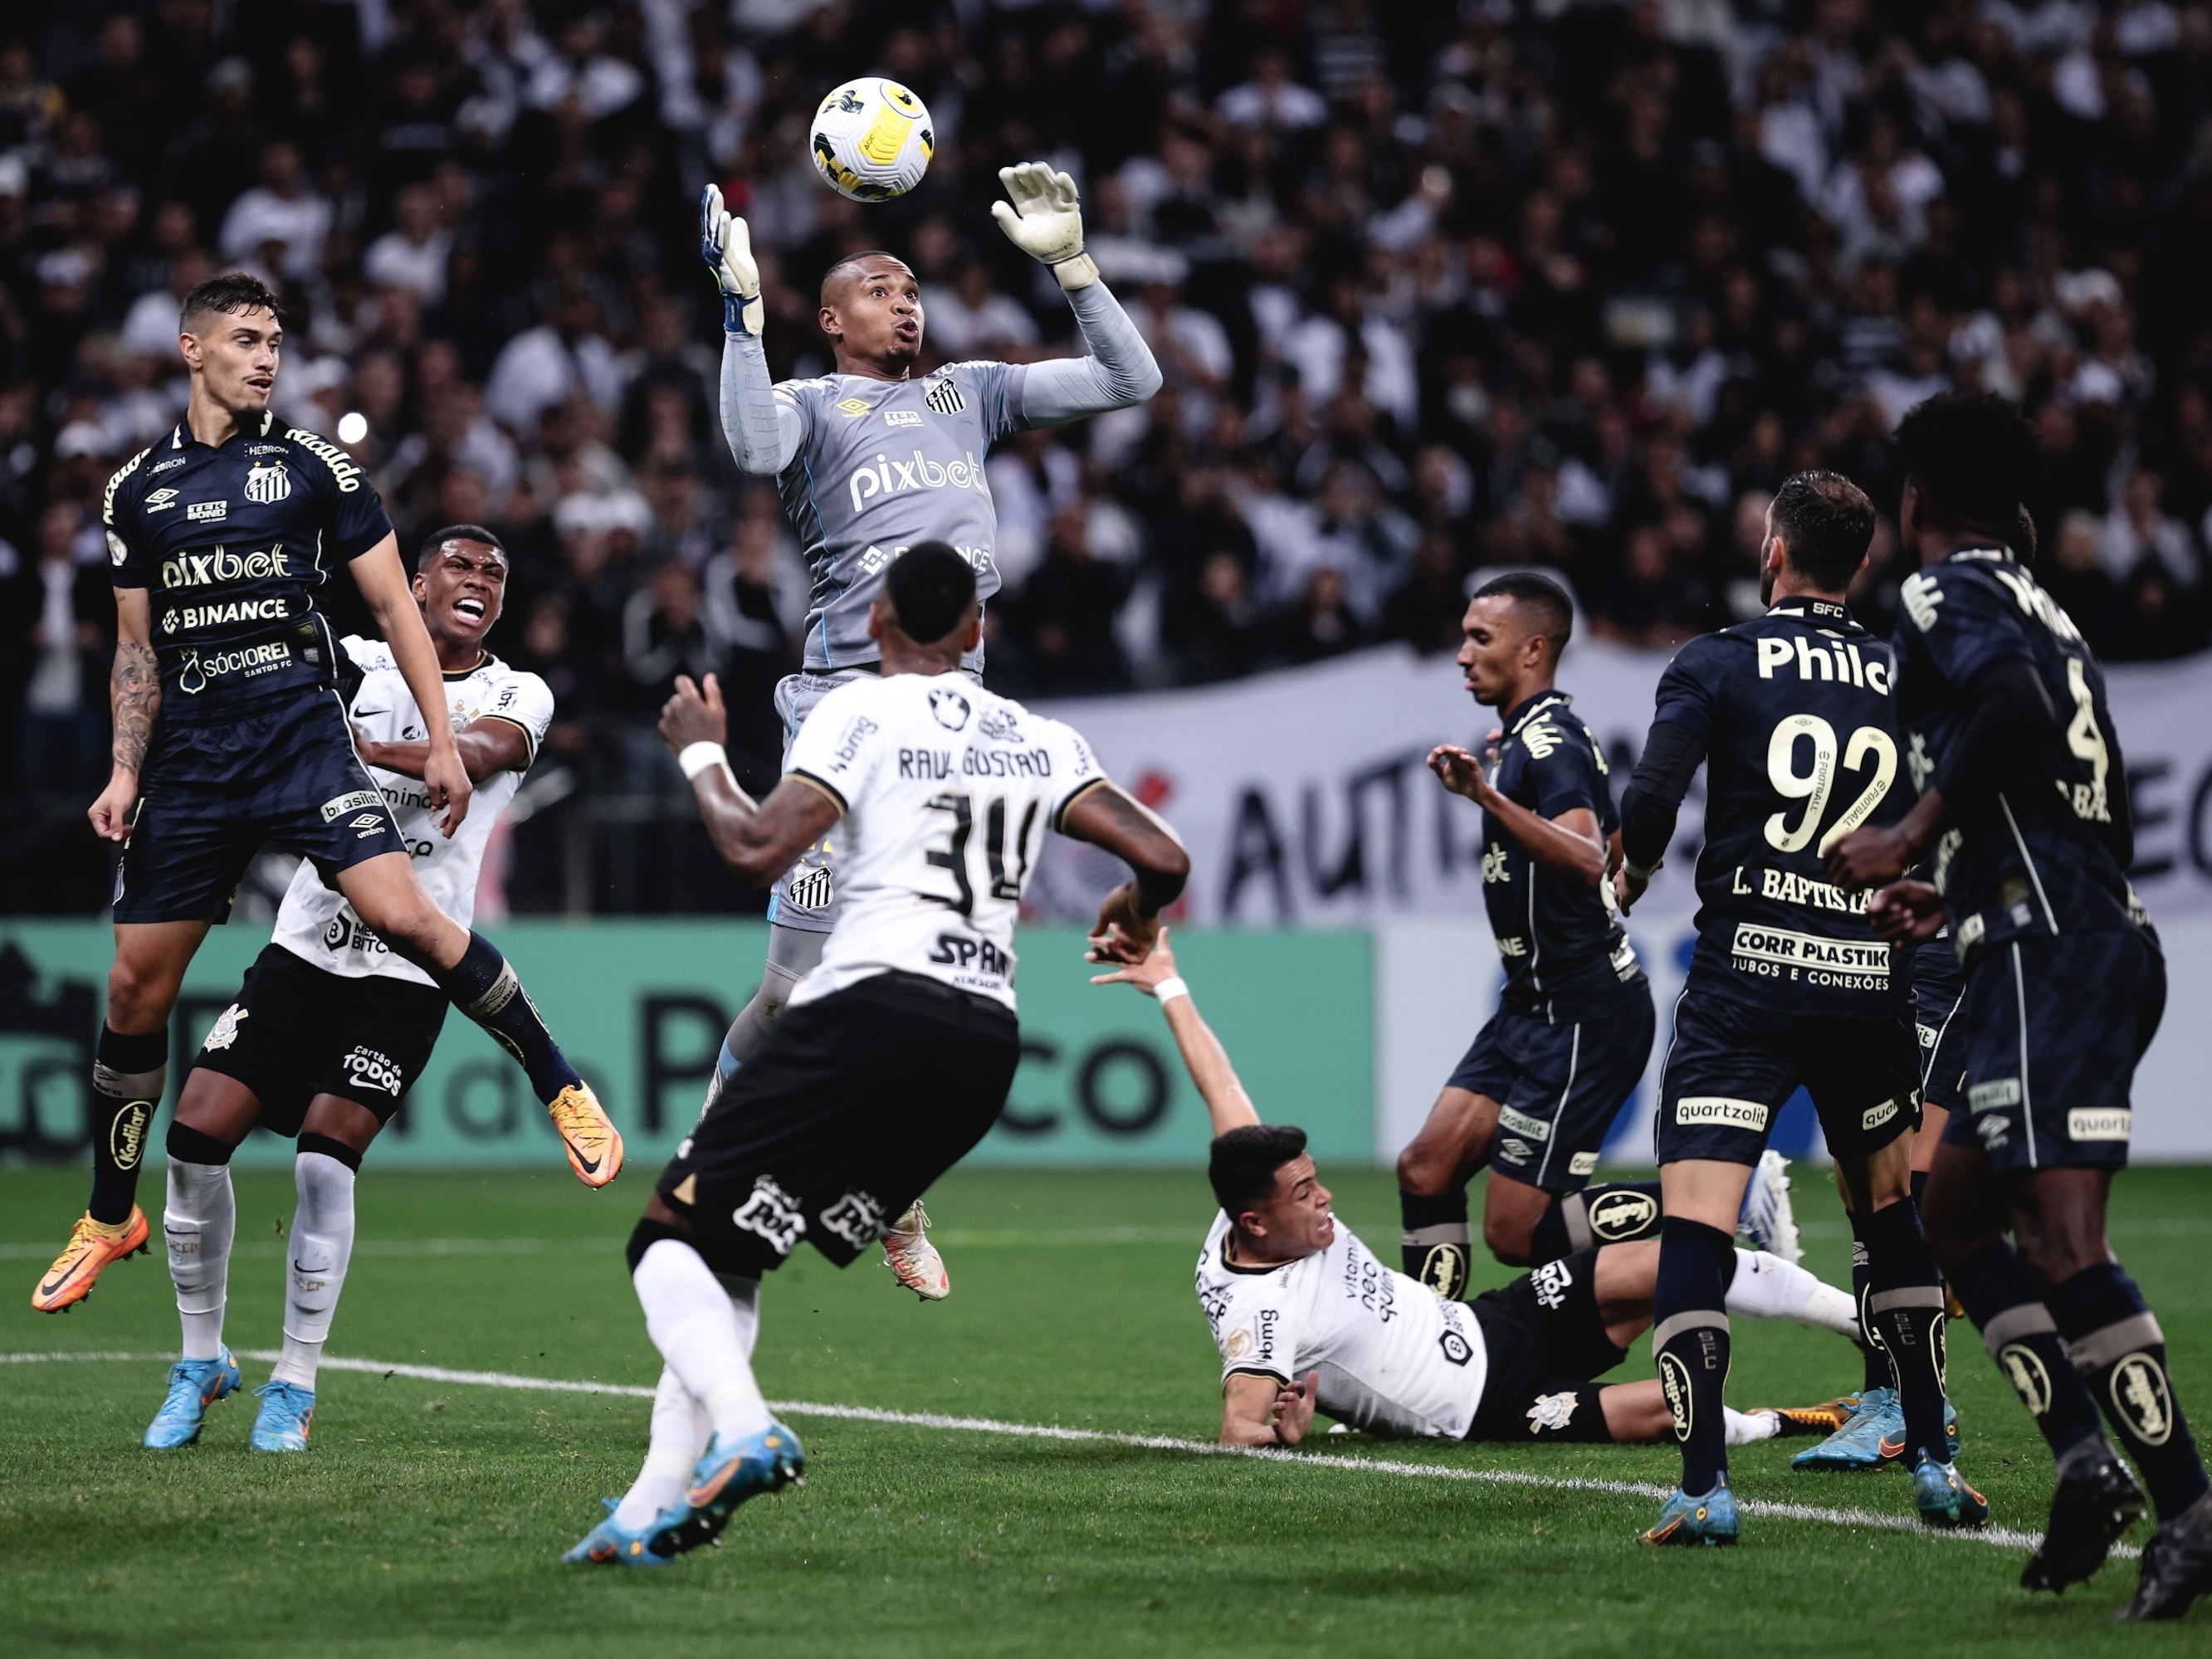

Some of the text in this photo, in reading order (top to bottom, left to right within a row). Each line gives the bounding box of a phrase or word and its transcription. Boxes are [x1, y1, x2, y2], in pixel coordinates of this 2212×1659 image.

[885, 417, 923, 427] BOND
[848, 449, 985, 514] pixbet
[147, 500, 176, 515] umbro
[187, 508, 227, 521] BOND
[189, 500, 227, 512] TEK
[162, 544, 292, 588] pixbet
[183, 598, 290, 629] BINANCE
[1812, 602, 1844, 618] SFC
[203, 641, 291, 679] SÓCIOREI
[243, 659, 292, 679] SANTOS FC
[1763, 713, 1898, 860] 92
[325, 793, 379, 817] brasilit
[357, 826, 386, 840] umbro
[916, 793, 1040, 917] 34
[1731, 866, 1752, 895] L.
[1736, 930, 1889, 968] CORR PLASTIK
[1731, 957, 1889, 991] TUBOS E CONEXÕES
[342, 1053, 402, 1097] TODOS
[354, 1045, 403, 1077] Cartão de
[1678, 1102, 1767, 1129] quartzolit
[119, 1105, 147, 1164] Kodilar
[1361, 1261, 1377, 1313] neo
[1259, 1309, 1279, 1354] bmg
[1662, 1361, 1687, 1429] Kodilar
